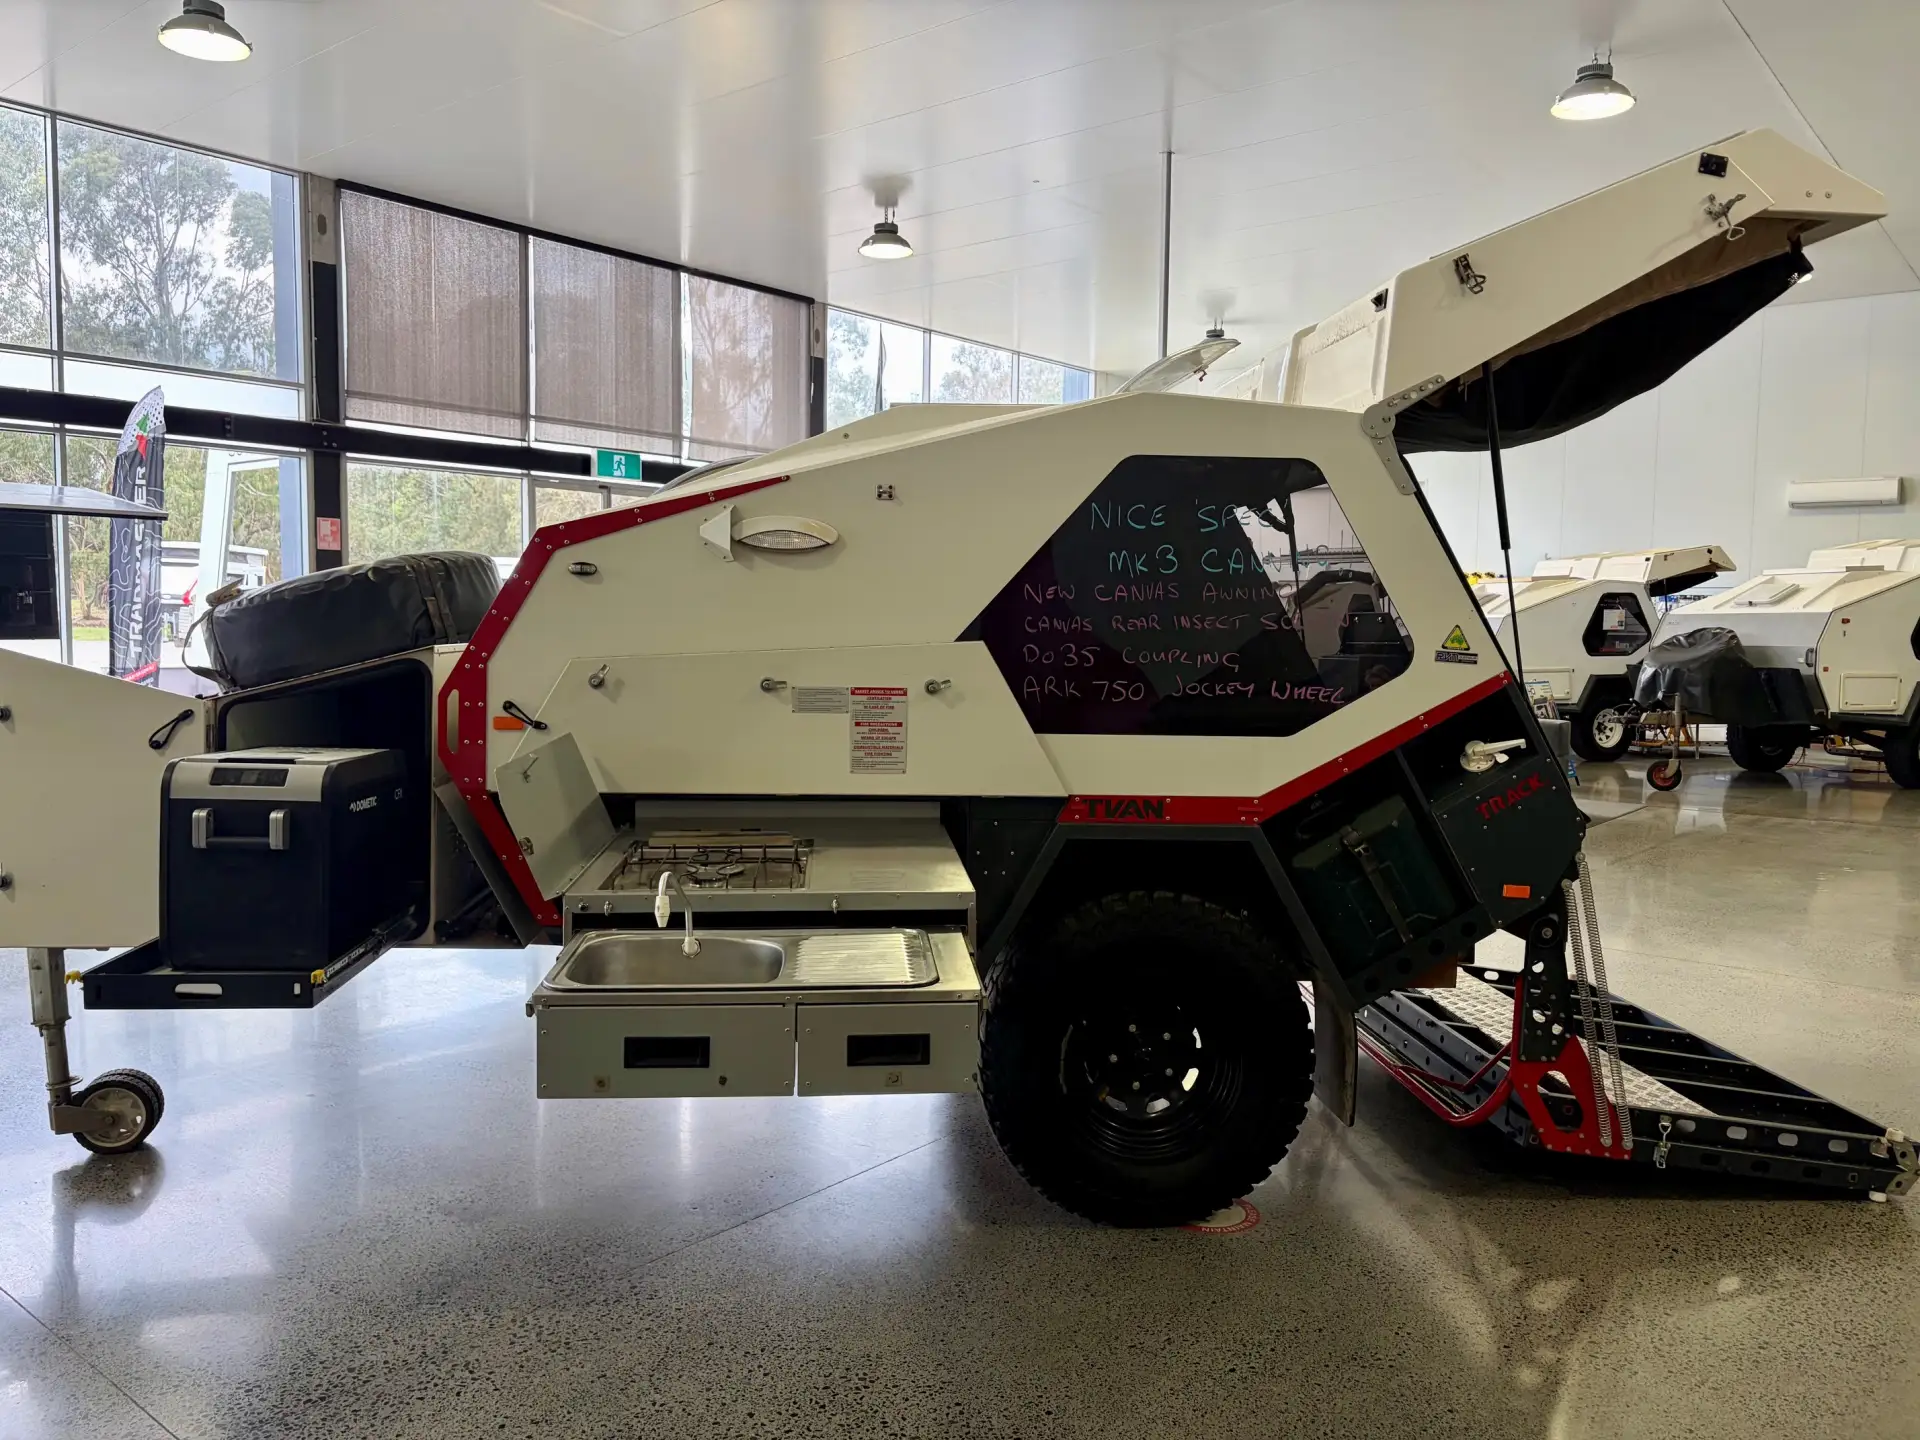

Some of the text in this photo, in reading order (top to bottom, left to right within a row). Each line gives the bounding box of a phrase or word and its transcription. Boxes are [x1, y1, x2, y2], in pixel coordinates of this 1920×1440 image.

[1091, 500, 1166, 531] NICE
[128, 465, 147, 660] TRAMASER
[1024, 583, 1076, 604] NEW
[1094, 581, 1179, 602] CANVAS
[1024, 615, 1093, 634] CANVAS
[1112, 614, 1161, 632] REAR
[1174, 614, 1249, 631] INSECT
[1123, 647, 1240, 672] COUPLING
[1023, 675, 1345, 704] ARK 750 JOCKEY WHEEL
[357, 796, 377, 812] DOMETIC
[1475, 772, 1544, 820] TRACK
[1083, 799, 1164, 820] TVAN
